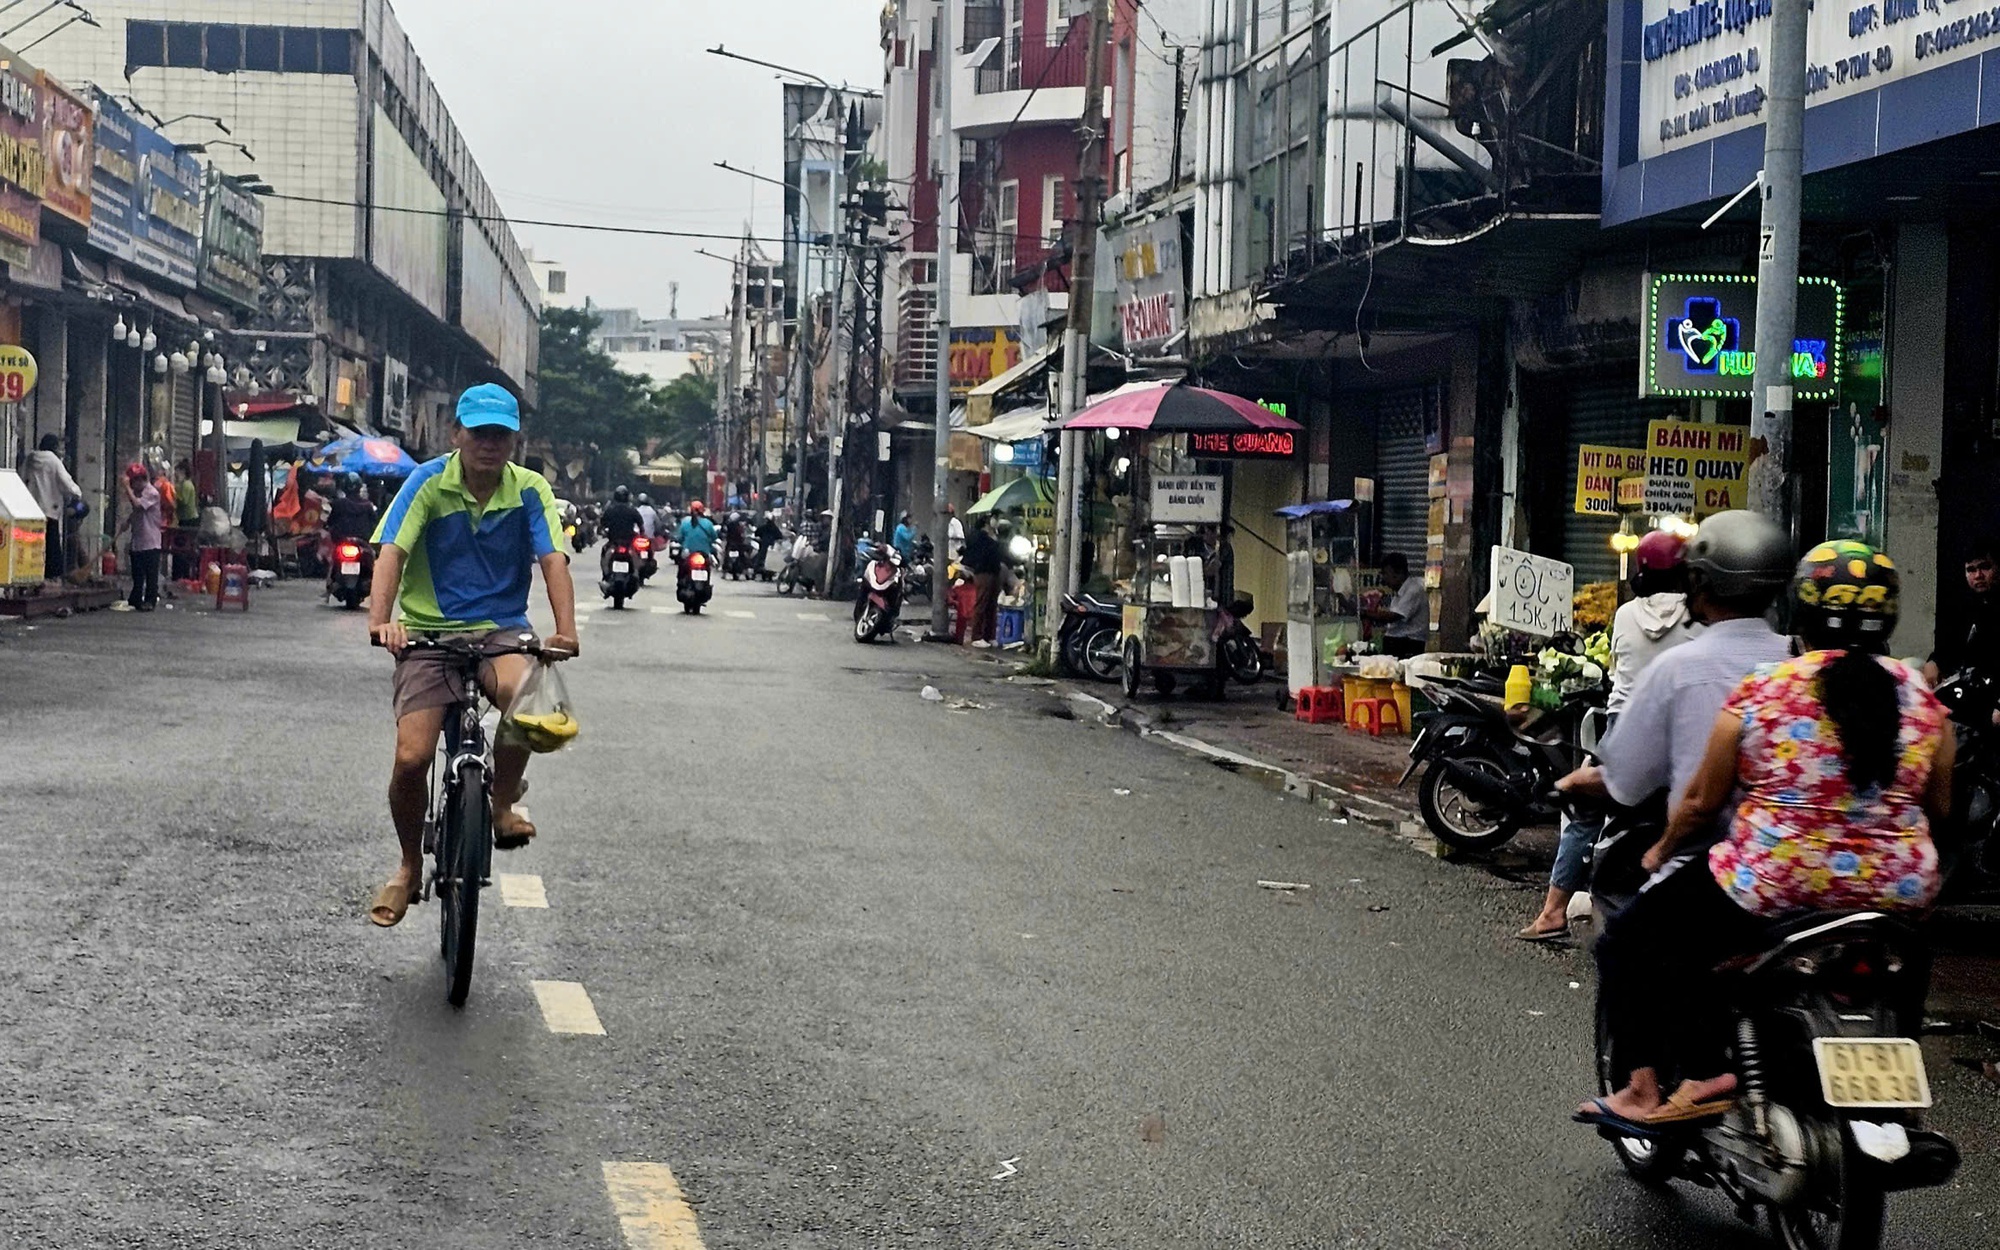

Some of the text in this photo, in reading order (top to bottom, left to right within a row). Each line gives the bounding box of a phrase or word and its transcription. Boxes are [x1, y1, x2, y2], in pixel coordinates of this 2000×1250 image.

[1656, 425, 1743, 451] BÁNH MÌ
[1606, 453, 1623, 469] DA
[1650, 456, 1744, 480] HEO QUAY
